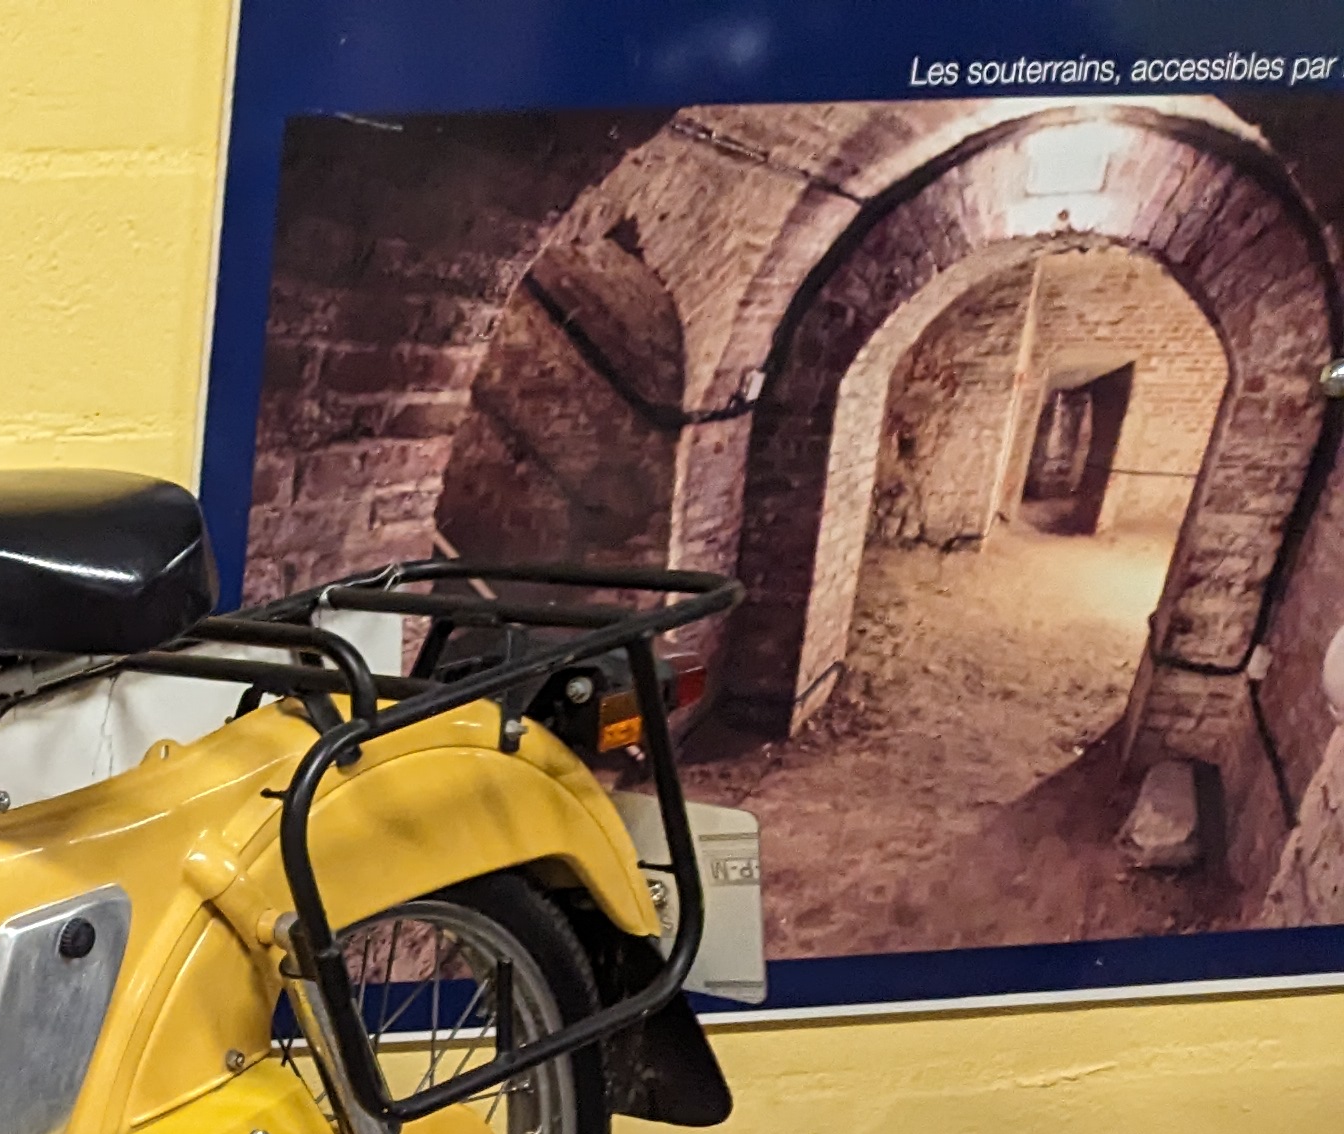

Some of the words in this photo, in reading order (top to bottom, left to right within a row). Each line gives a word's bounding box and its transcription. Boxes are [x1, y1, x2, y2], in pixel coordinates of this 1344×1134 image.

[910, 57, 959, 86] Les
[967, 54, 1120, 85] souterrains,
[1131, 52, 1285, 82] accessibles
[1290, 57, 1338, 86] par
